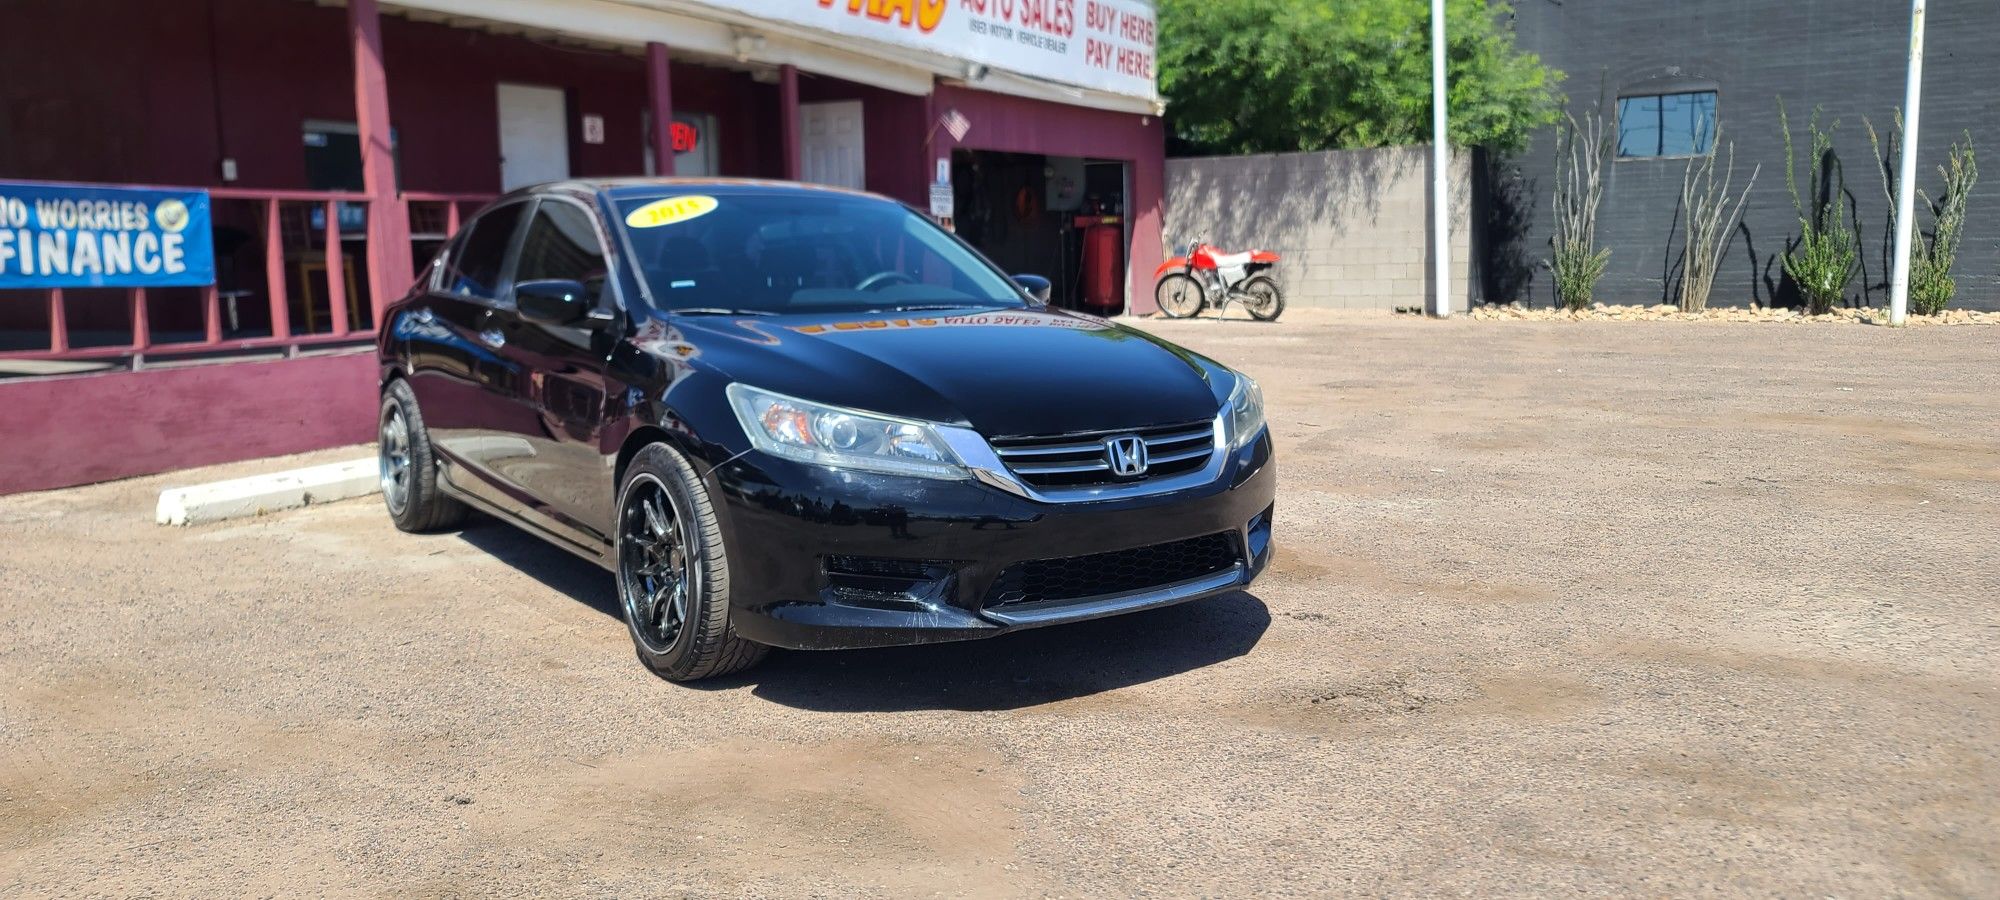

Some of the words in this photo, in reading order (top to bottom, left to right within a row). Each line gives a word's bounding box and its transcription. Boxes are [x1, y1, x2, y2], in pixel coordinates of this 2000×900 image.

[1020, 0, 1074, 39] SALES
[1086, 1, 1116, 34] BUY
[1120, 11, 1154, 47] HERE
[1086, 38, 1113, 71] PAY
[1116, 47, 1152, 80] HERE
[671, 122, 697, 152] EN
[35, 197, 150, 231] WORRIES
[0, 229, 186, 277] FINANCE
